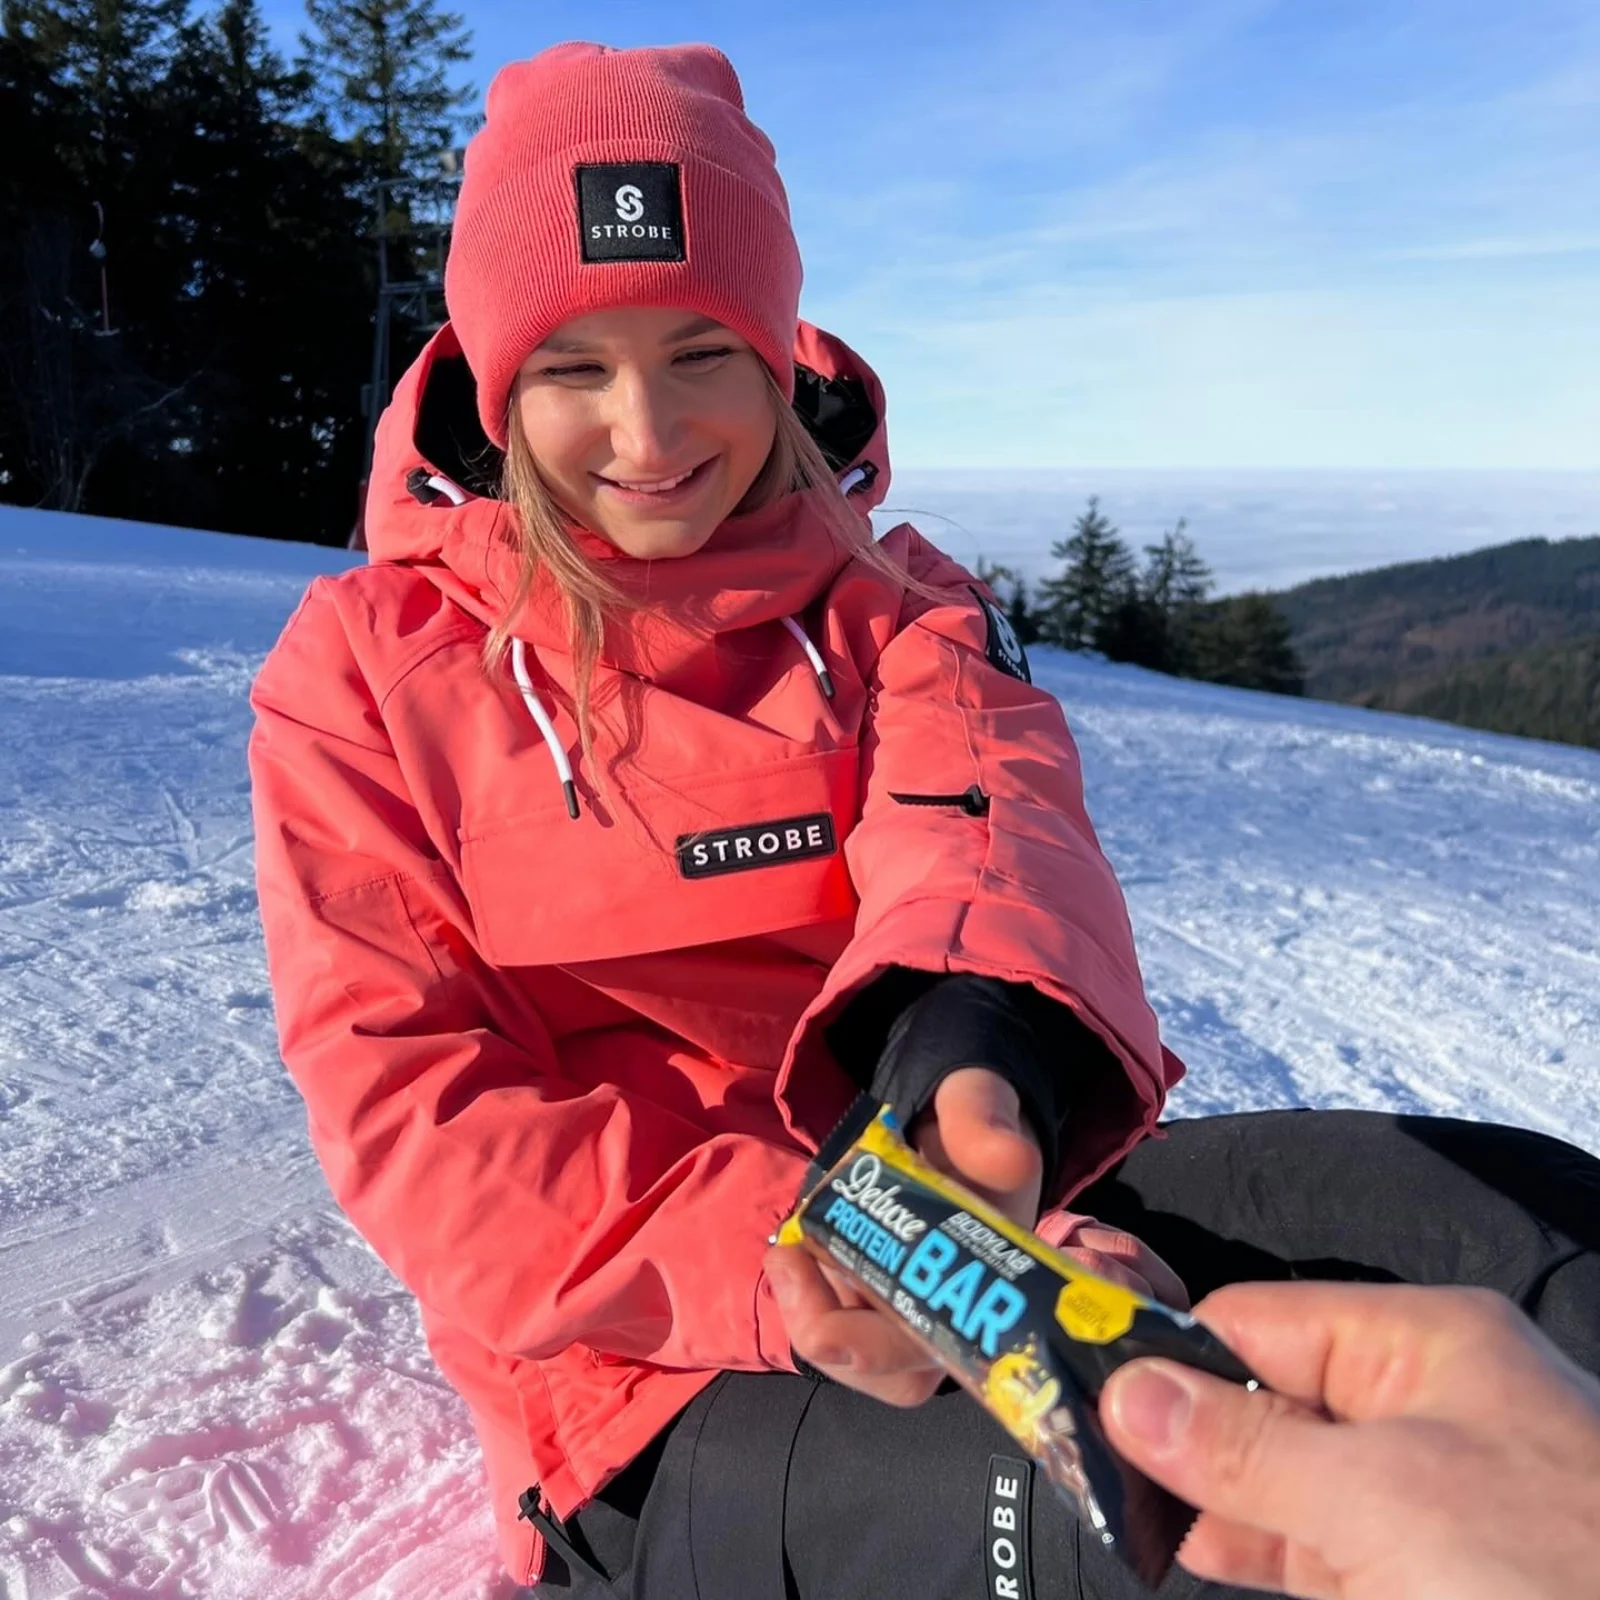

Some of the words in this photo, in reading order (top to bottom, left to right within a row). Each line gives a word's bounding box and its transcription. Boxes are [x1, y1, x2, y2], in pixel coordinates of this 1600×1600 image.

[591, 225, 672, 240] STROBE
[693, 825, 823, 866] STROBE
[831, 1153, 928, 1241] Deluxe
[824, 1196, 907, 1275] PROTEIN
[947, 1210, 1036, 1275] BODYLAB
[899, 1227, 1029, 1358] BAR
